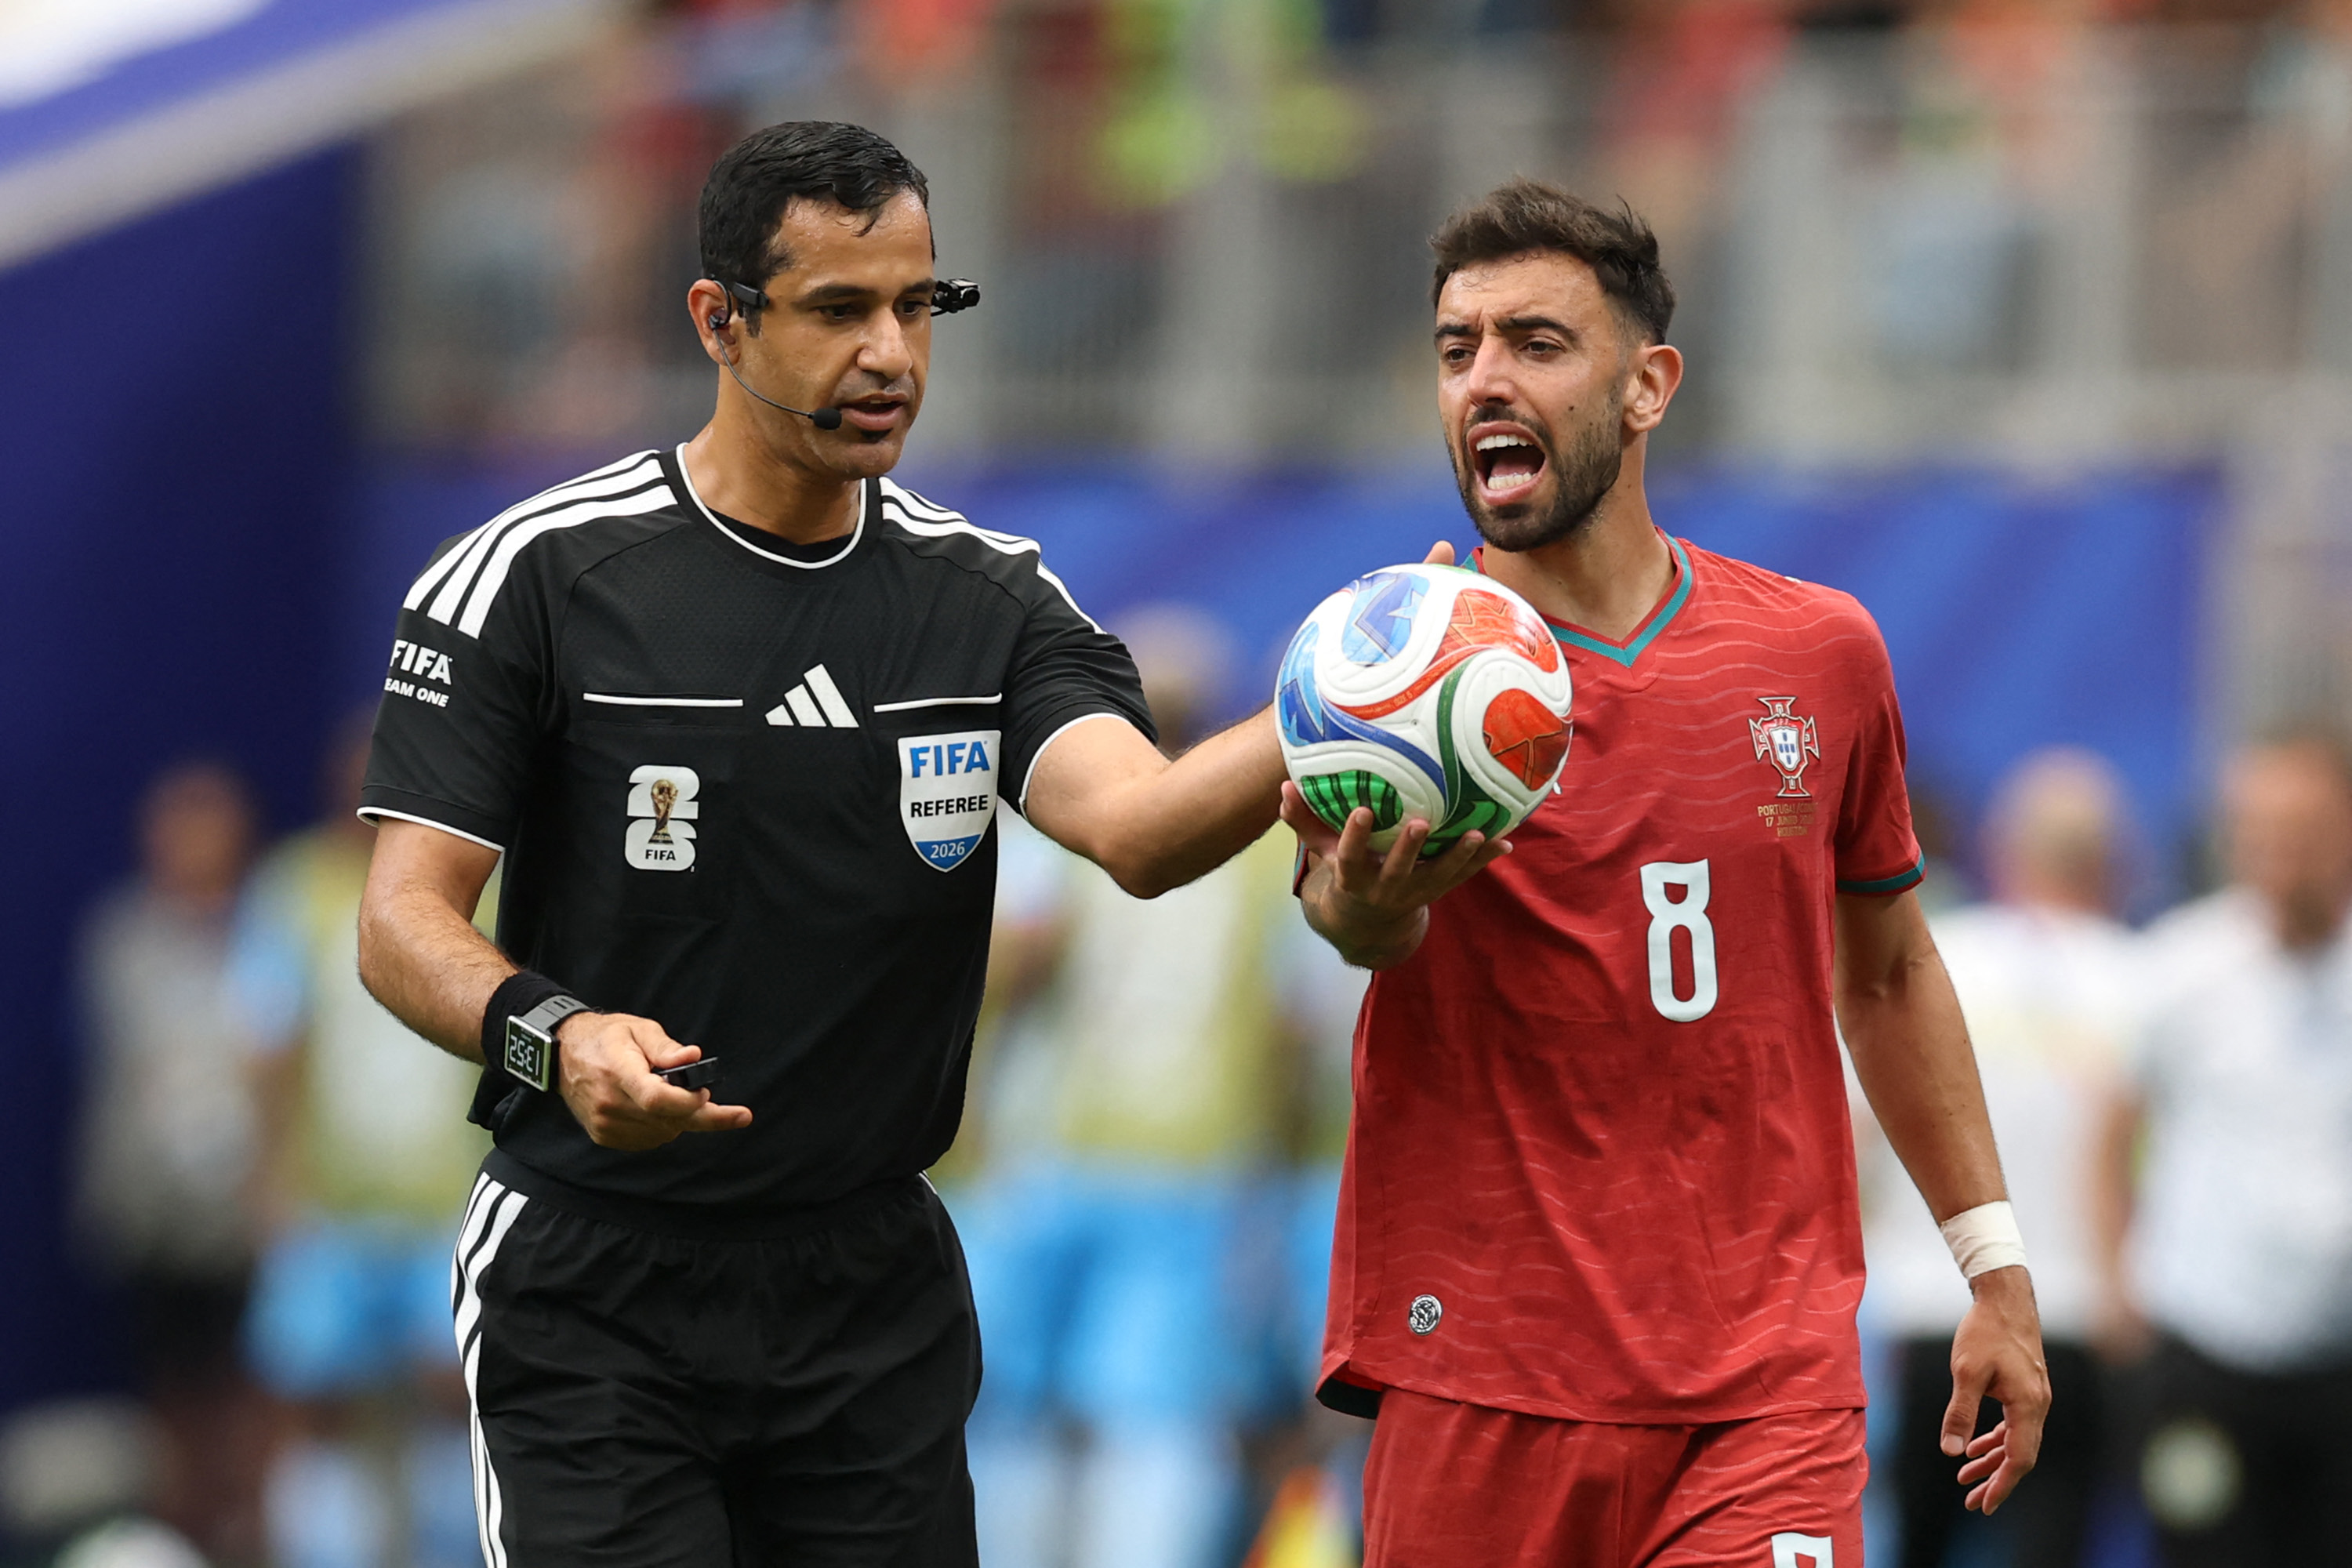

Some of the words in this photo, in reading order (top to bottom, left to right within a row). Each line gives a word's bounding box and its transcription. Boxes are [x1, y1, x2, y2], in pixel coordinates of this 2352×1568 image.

[390, 639, 452, 685] FIFA
[384, 678, 416, 697] EAM
[416, 687, 449, 707] ONE
[909, 741, 991, 779] FIFA
[910, 794, 989, 818] REFEREE
[1766, 816, 1773, 827] 17
[645, 849, 676, 861] FIFA
[930, 841, 966, 859] 2026
[1639, 858, 1719, 1022] 8
[510, 1035, 539, 1076] 13:52
